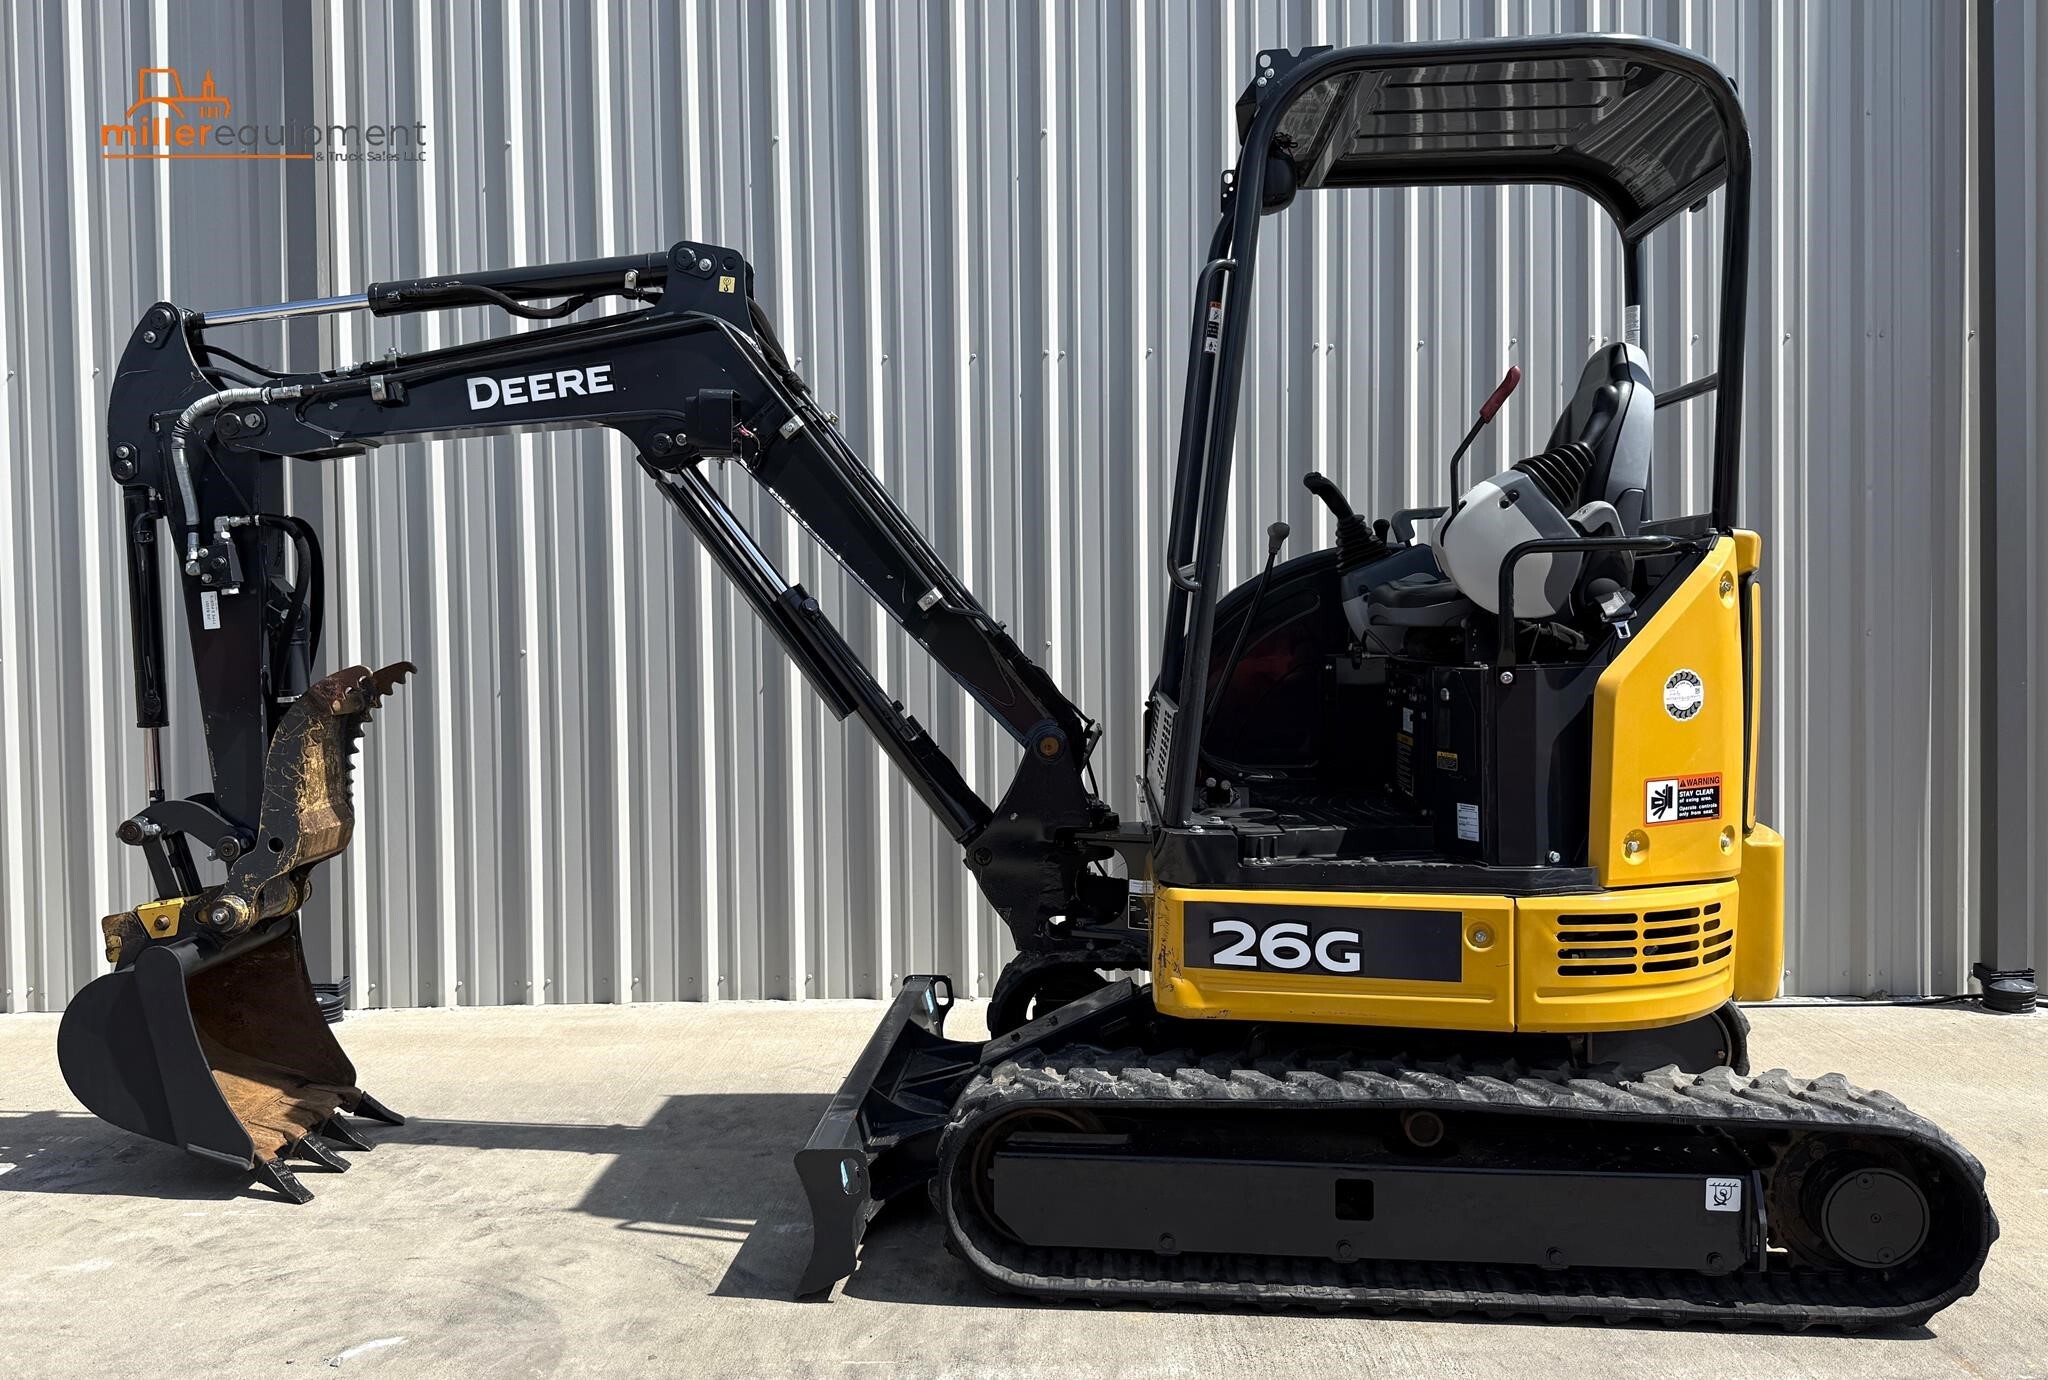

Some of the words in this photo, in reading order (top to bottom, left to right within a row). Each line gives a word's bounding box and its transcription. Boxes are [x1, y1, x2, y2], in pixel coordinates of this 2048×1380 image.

[466, 364, 614, 411] DEERE
[1679, 790, 1694, 798] STAY
[1695, 788, 1714, 796] CLEAR
[1686, 776, 1720, 787] WARNING
[1212, 919, 1361, 973] 26G
